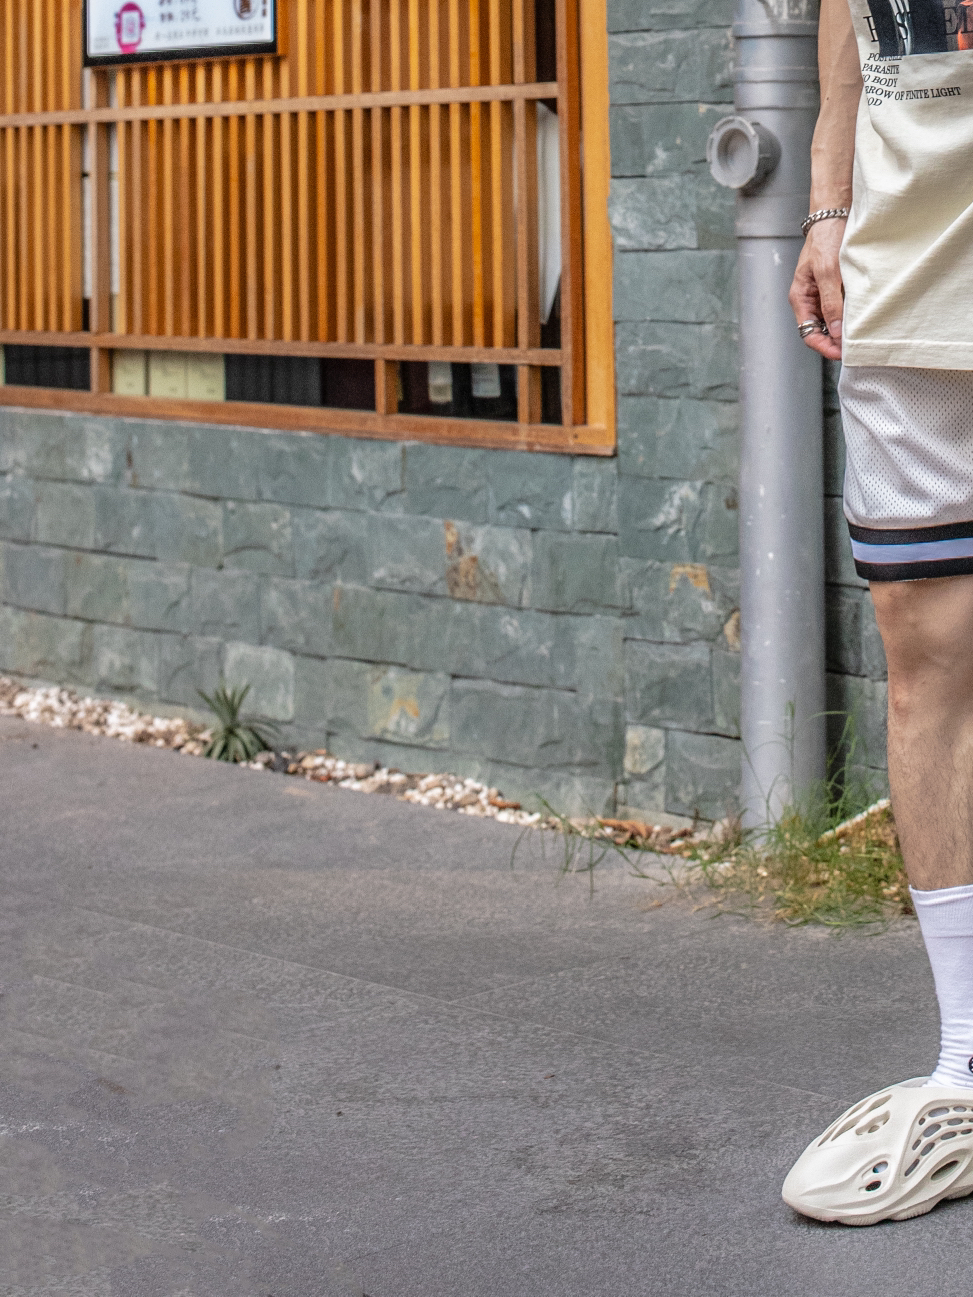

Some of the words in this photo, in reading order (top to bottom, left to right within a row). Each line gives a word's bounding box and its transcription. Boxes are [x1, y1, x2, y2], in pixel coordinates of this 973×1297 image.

[862, 63, 900, 75] PARASITE
[872, 75, 899, 88] BODY
[894, 90, 905, 101] OF
[905, 88, 930, 100] FINITE
[930, 86, 962, 99] LIGHT
[867, 96, 883, 107] OD
